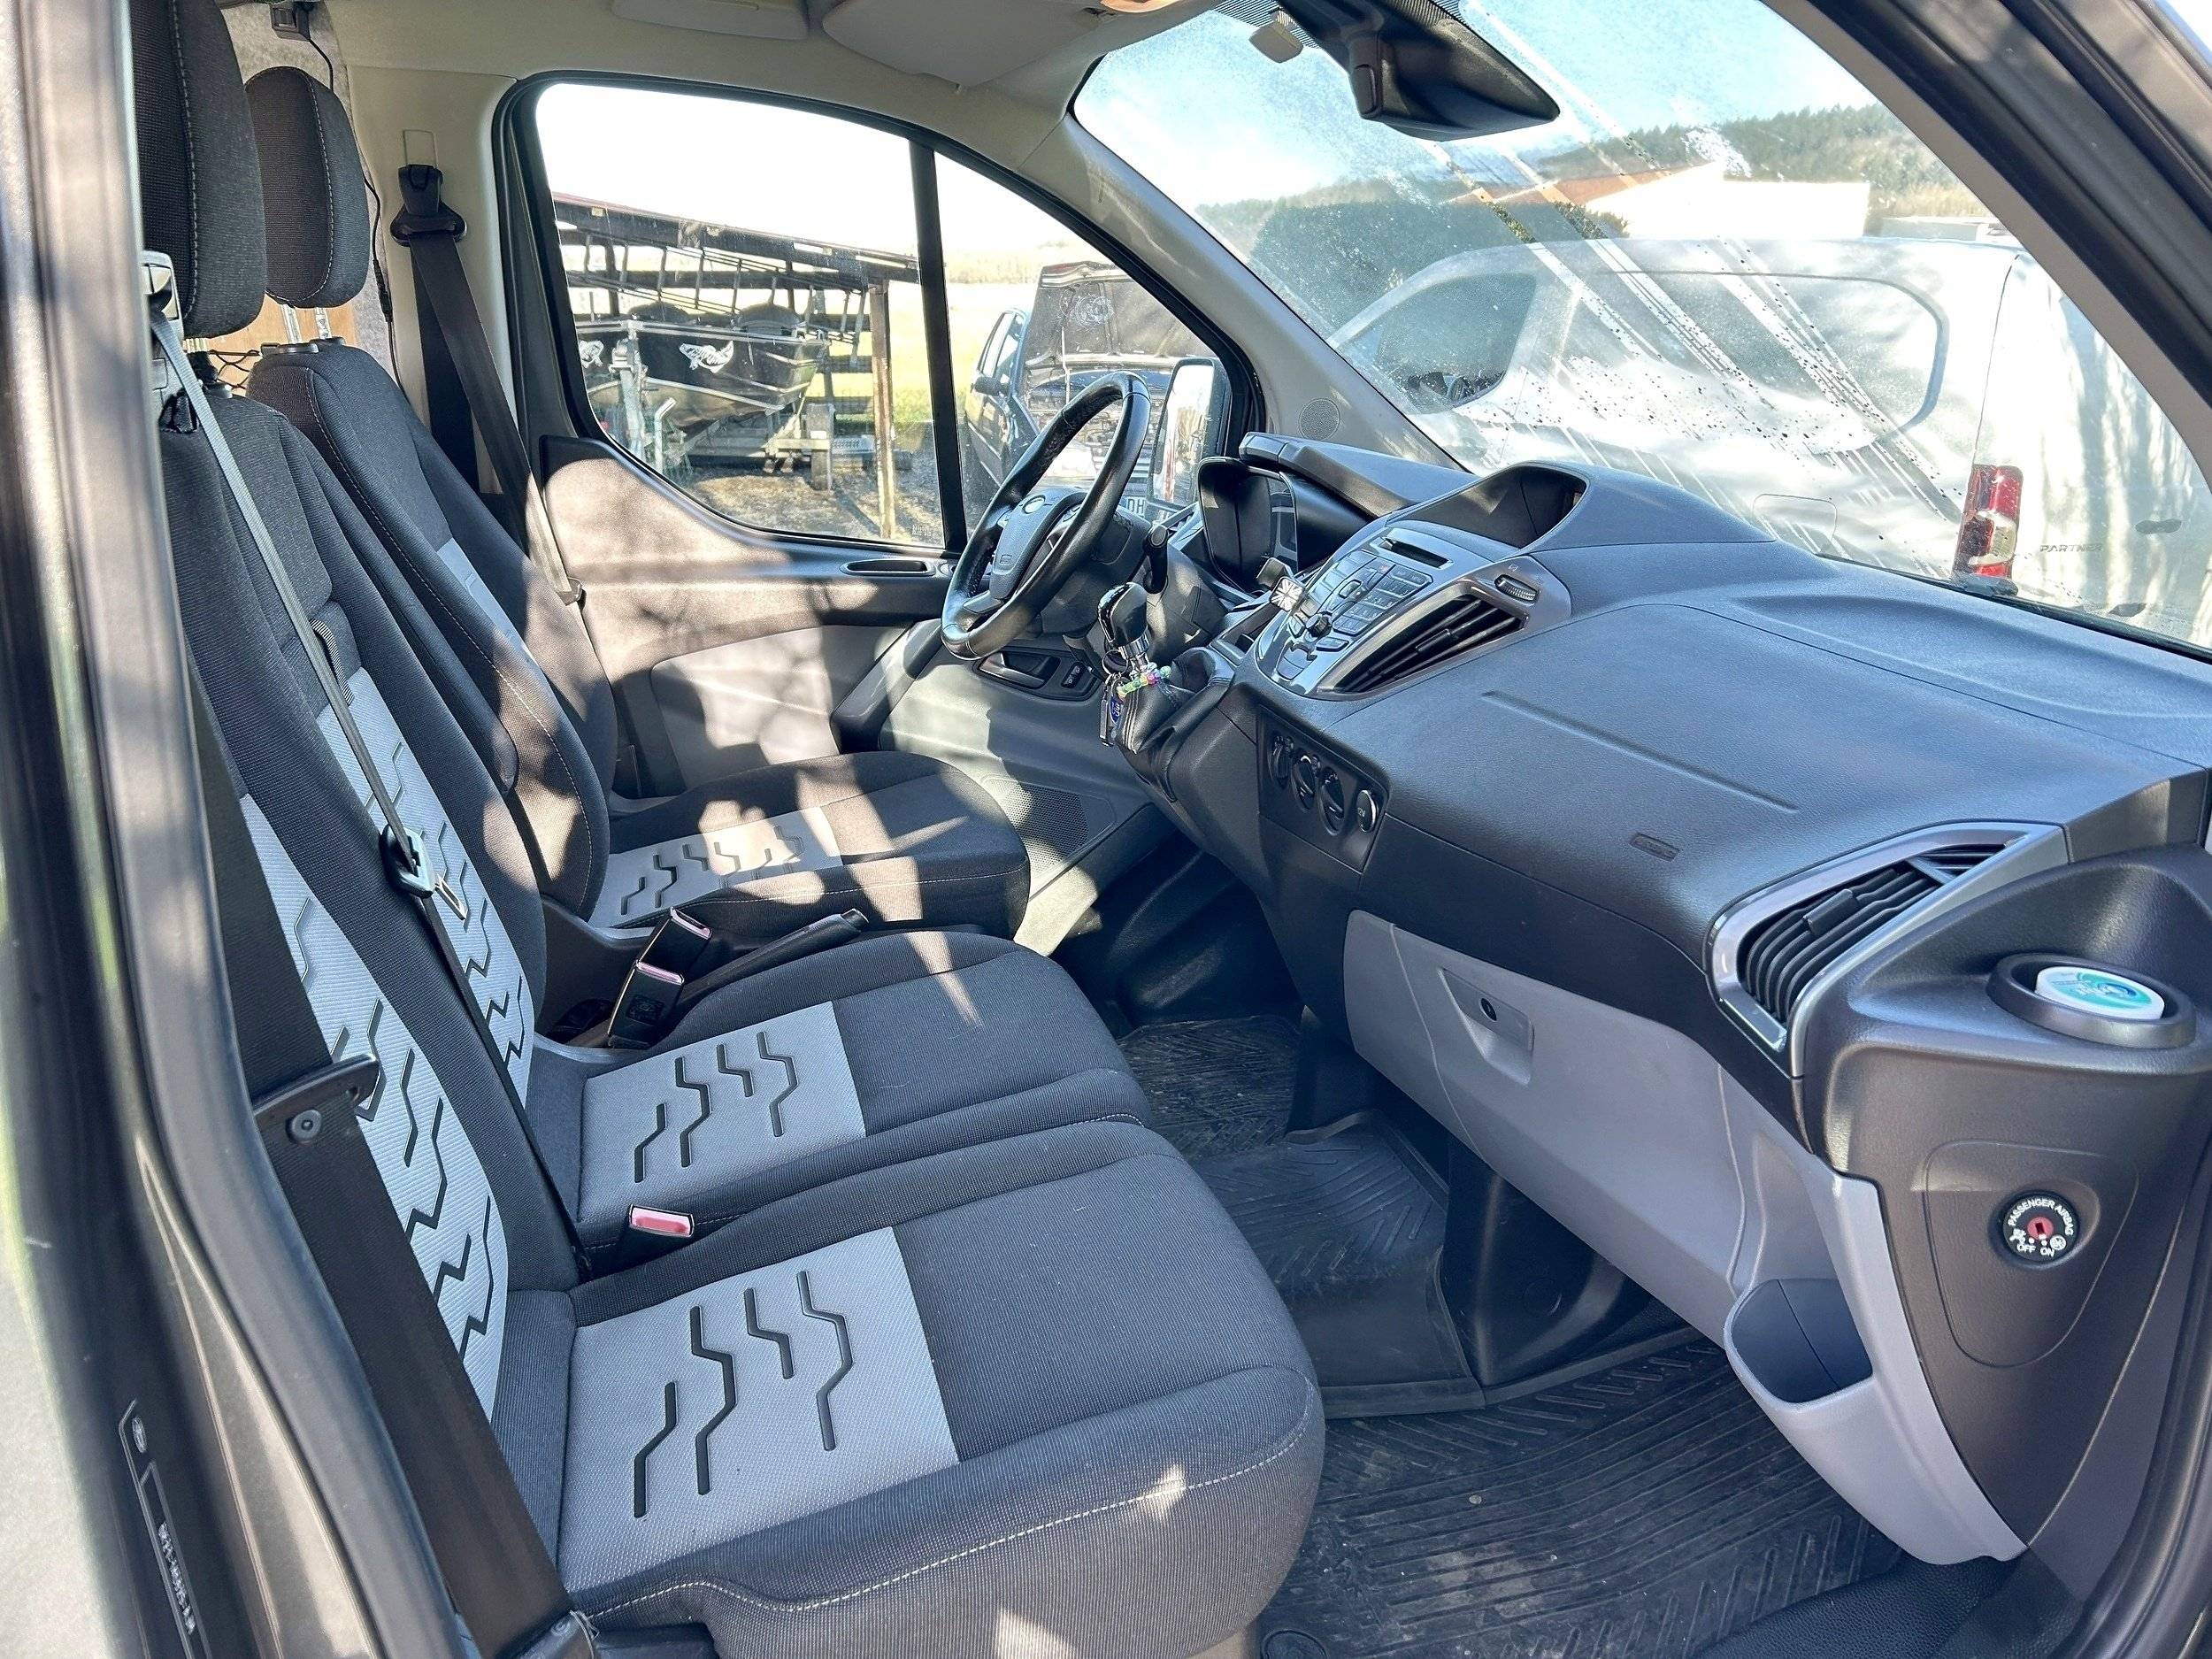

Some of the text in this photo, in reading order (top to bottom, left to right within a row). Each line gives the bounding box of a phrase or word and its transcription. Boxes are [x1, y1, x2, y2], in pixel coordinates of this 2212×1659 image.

[2039, 543, 2103, 552] PARTNER
[2007, 1198, 2074, 1236] PASSENGER AIRBAG
[2016, 1244, 2036, 1254] OFF
[2039, 1247, 2055, 1257] ON
